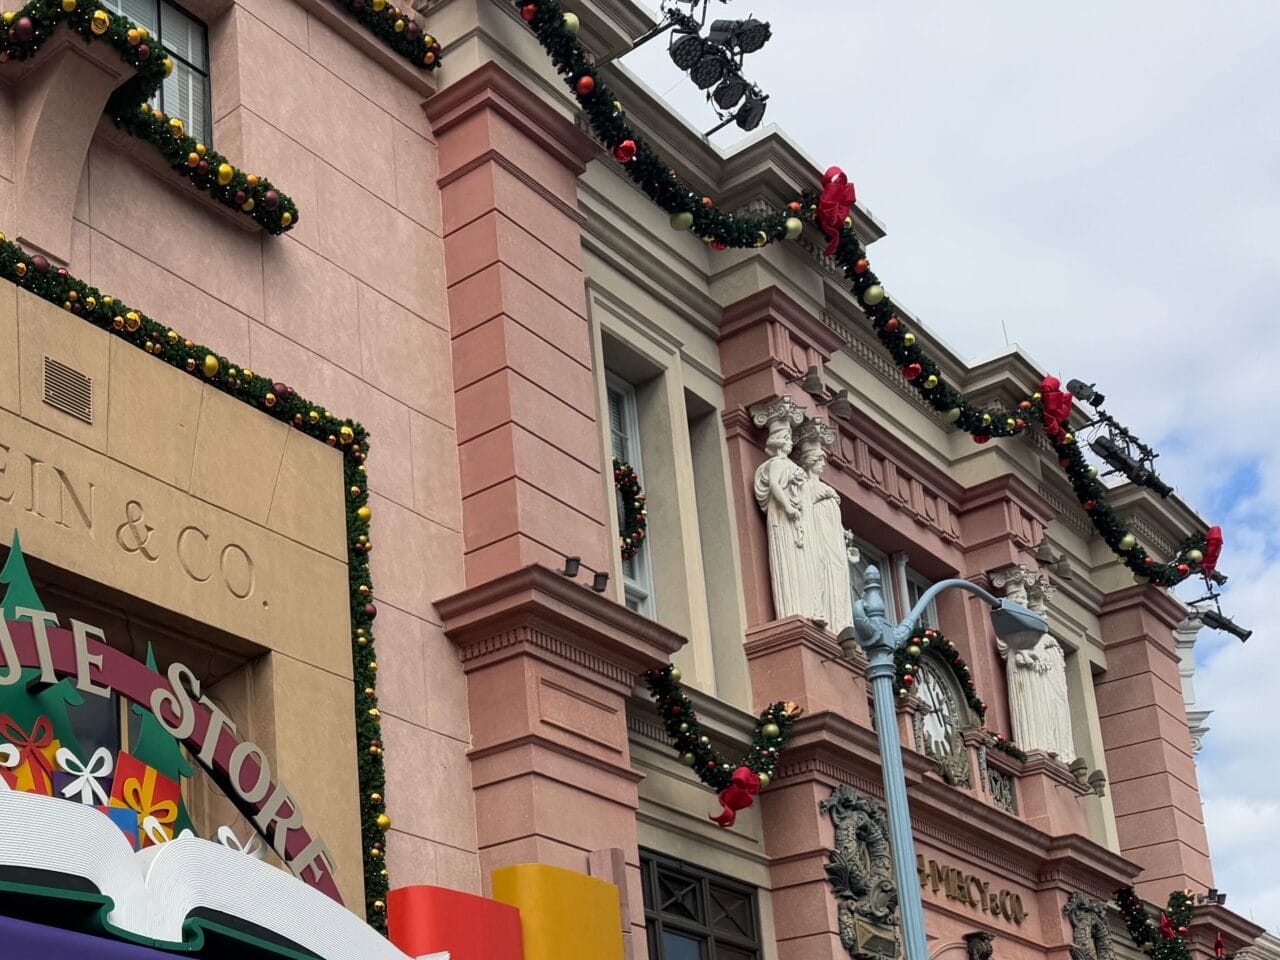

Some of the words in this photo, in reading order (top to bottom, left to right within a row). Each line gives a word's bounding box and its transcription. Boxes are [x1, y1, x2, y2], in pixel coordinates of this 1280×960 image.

[116, 500, 160, 563] &
[176, 525, 271, 610] CO.
[150, 662, 337, 885] STORE
